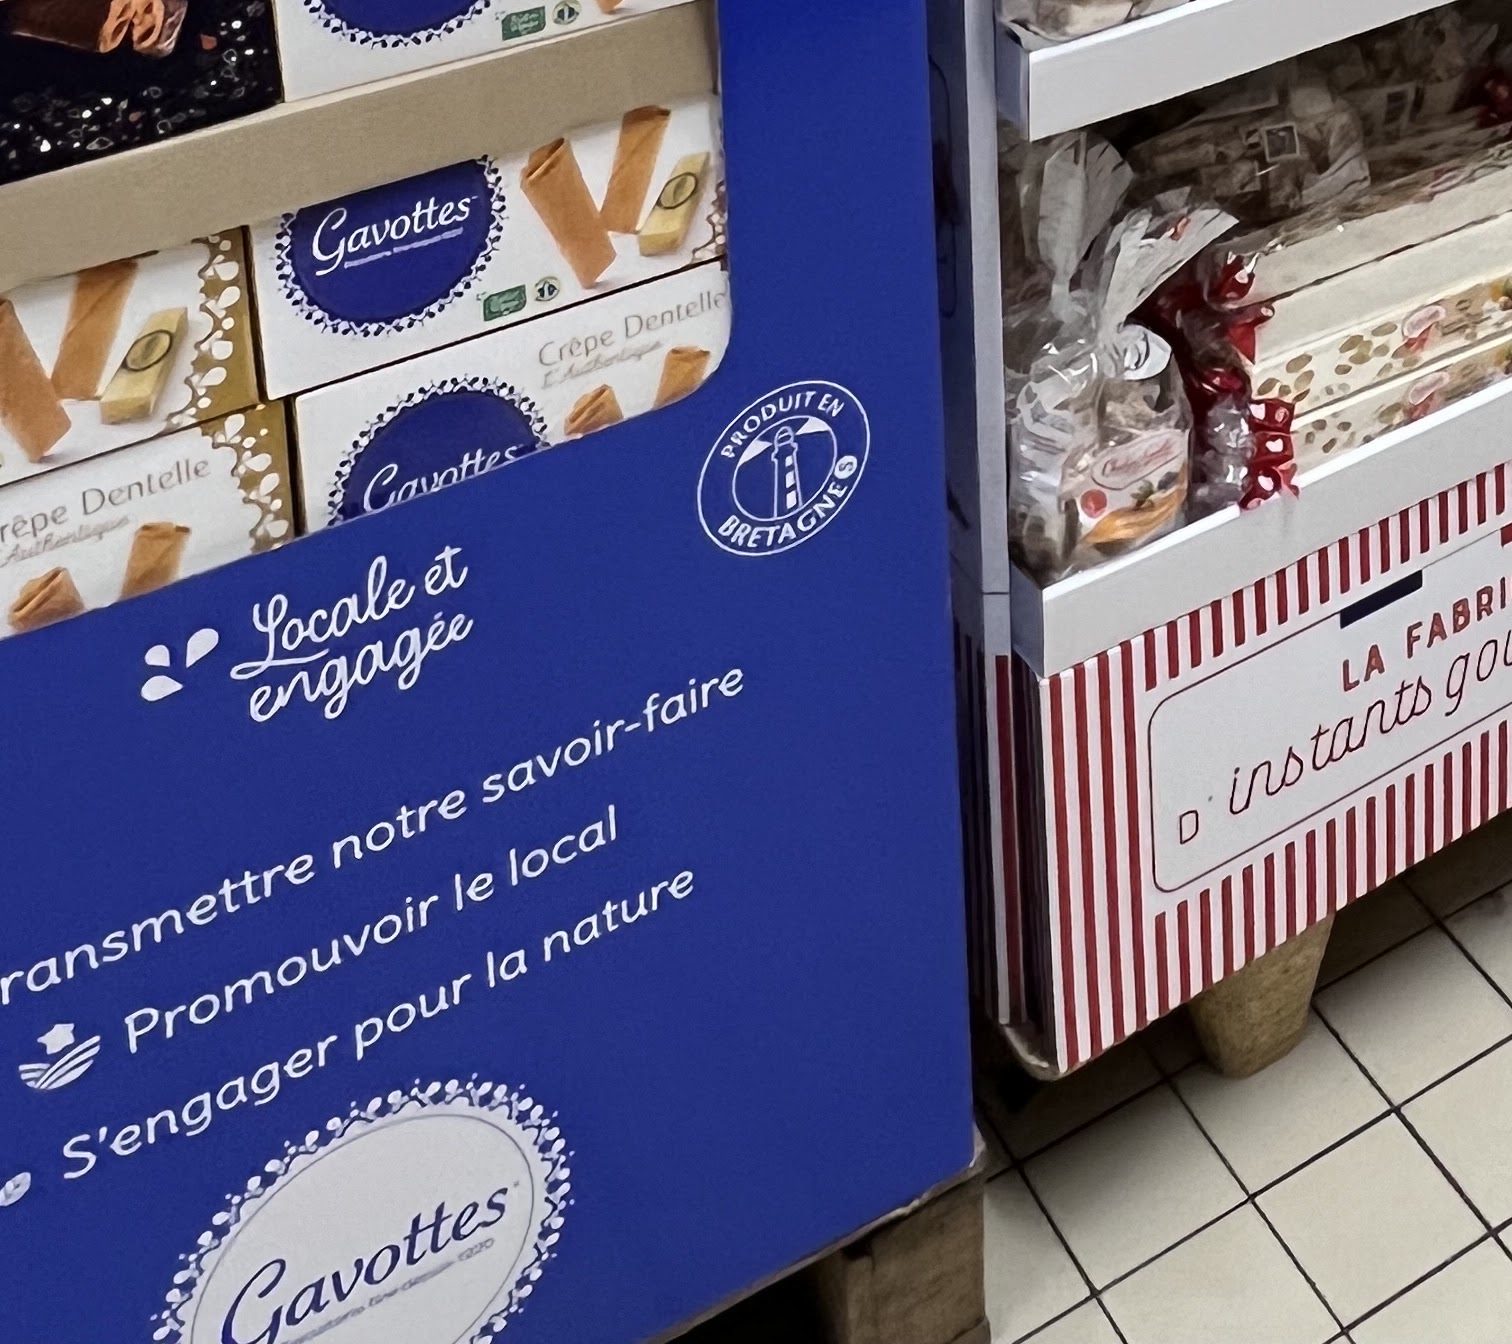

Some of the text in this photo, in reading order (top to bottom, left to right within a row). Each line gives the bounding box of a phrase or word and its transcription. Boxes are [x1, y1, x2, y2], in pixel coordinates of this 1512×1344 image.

[311, 195, 472, 276] Gavottes
[539, 327, 615, 367] Crêpe
[720, 391, 845, 458] PRODUIT EN
[82, 455, 210, 517] Dentelle
[718, 481, 848, 548] BRETAGNE
[230, 545, 469, 680] Locale et
[248, 612, 474, 723] engagée
[1341, 642, 1387, 694] LA
[331, 787, 467, 873] notre
[481, 666, 746, 806] savoir-faire
[124, 805, 620, 1055] Promouvoir le local
[63, 866, 698, 1181] S'engager pour la nature
[221, 1186, 509, 1344] Gavottes
